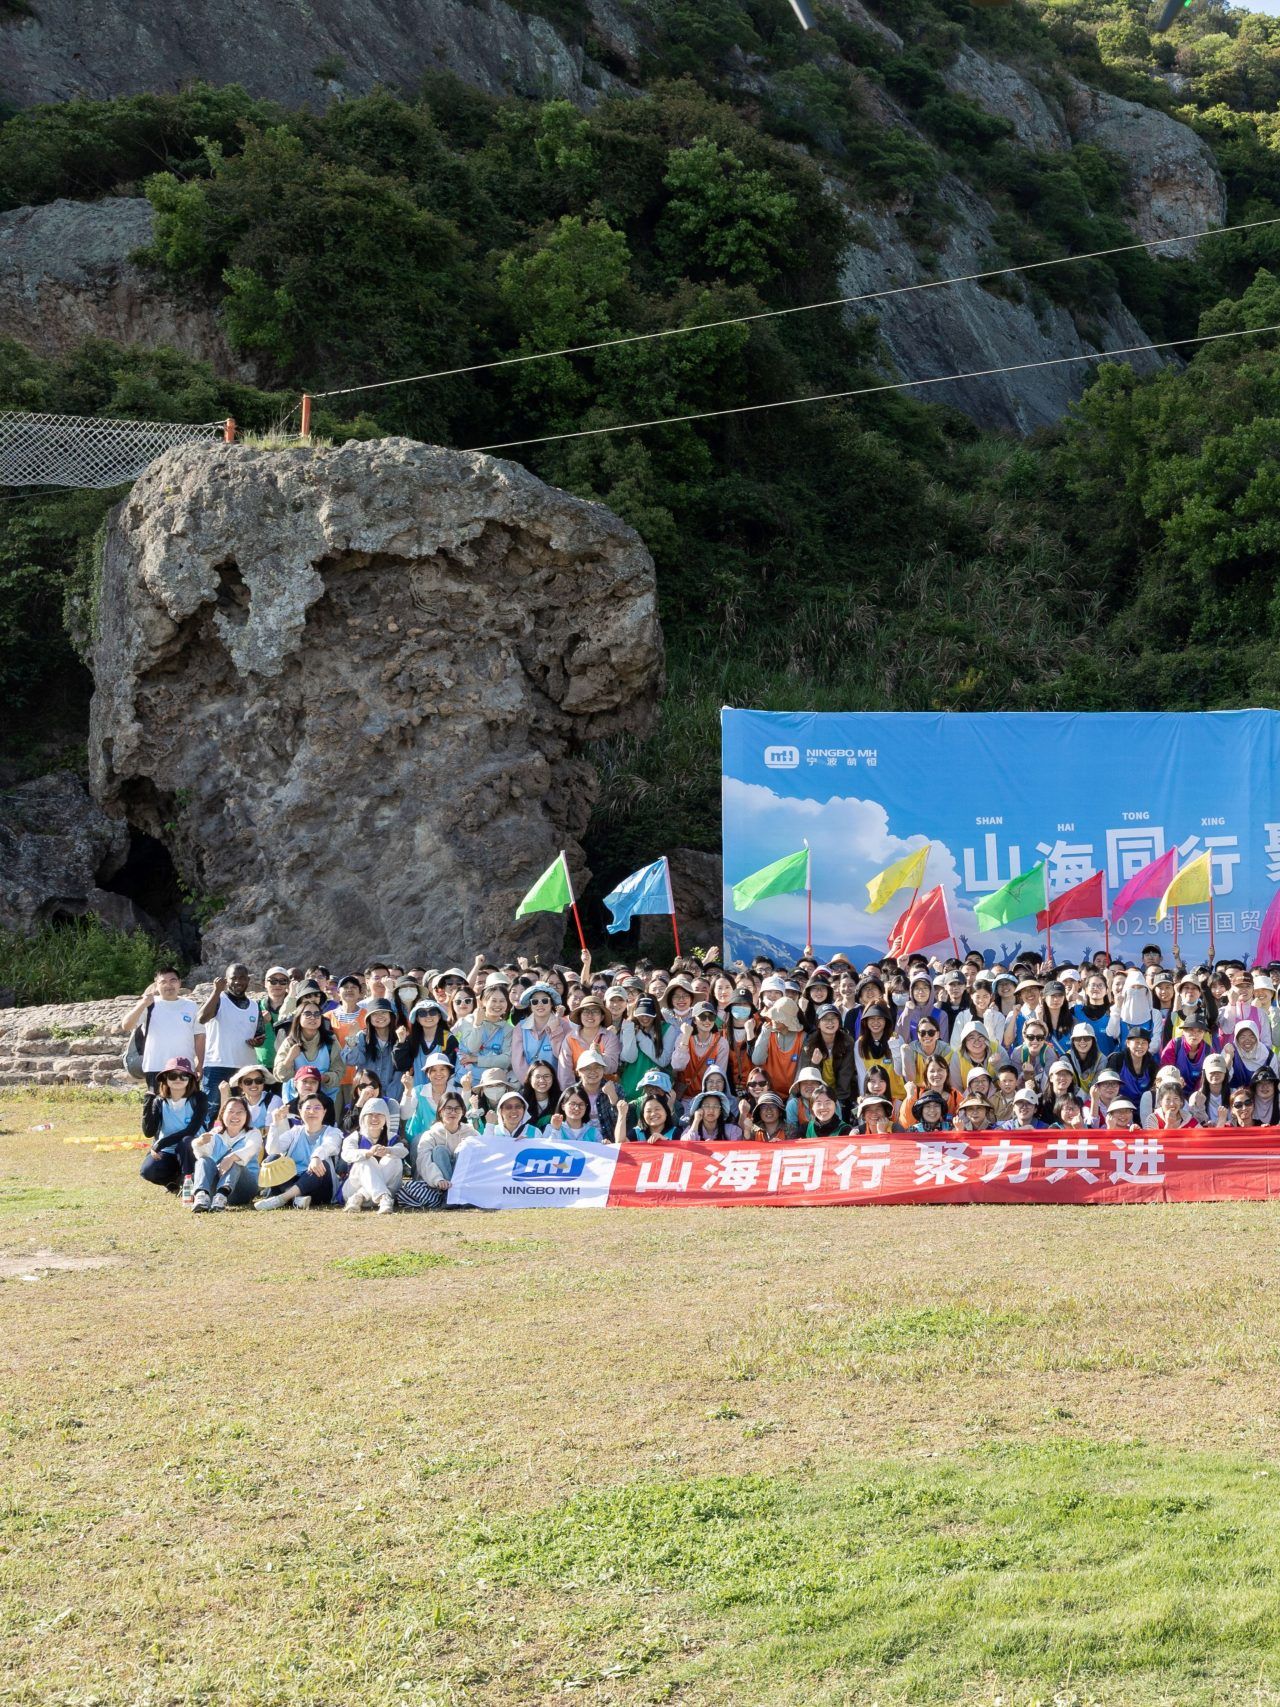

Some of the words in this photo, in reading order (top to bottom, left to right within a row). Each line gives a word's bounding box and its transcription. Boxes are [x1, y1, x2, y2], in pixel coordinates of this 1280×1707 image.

[807, 749, 854, 757] NINGBO
[858, 749, 877, 757] MH
[807, 757, 877, 766] 宁波萌恒
[975, 816, 1003, 825] SHAN
[1057, 823, 1075, 832] HAI
[1122, 812, 1150, 821] TONG
[1201, 817, 1225, 826] XING
[963, 826, 1241, 895] 山海同行
[635, 1144, 891, 1193] 山海同行
[913, 1138, 1166, 1185] 聚力共进
[502, 1186, 556, 1195] NINGBO
[559, 1187, 580, 1195] MH
